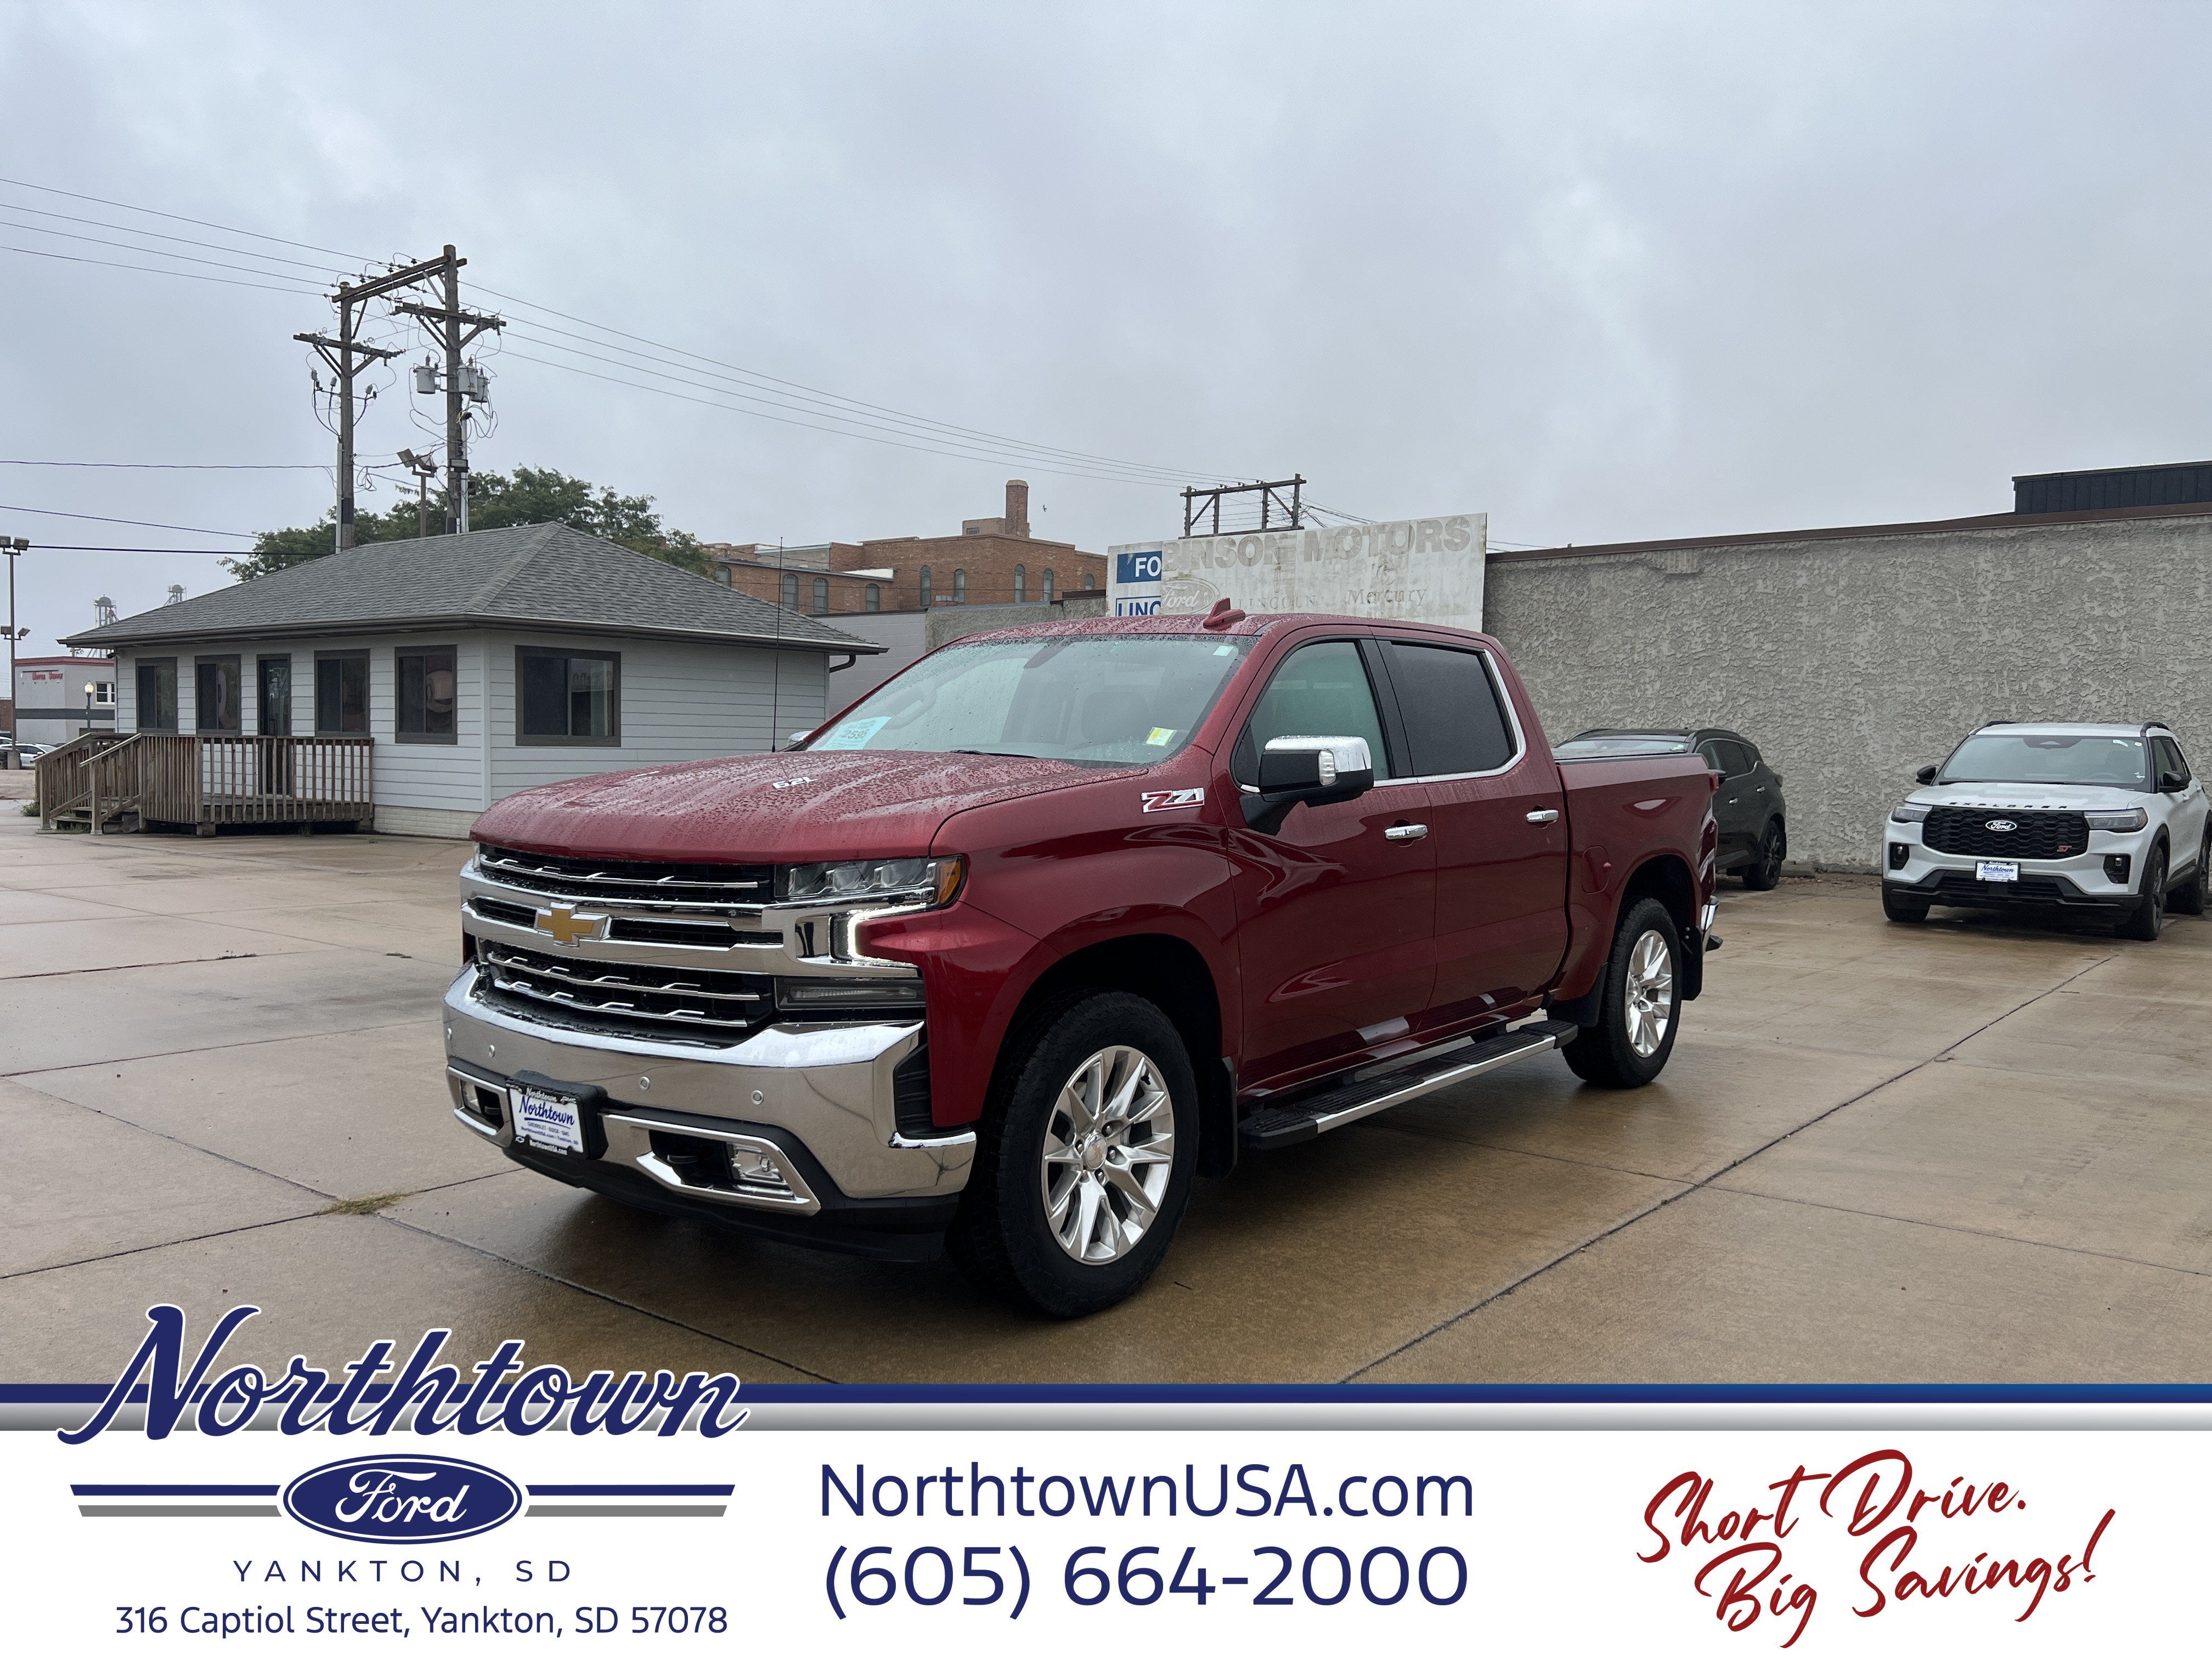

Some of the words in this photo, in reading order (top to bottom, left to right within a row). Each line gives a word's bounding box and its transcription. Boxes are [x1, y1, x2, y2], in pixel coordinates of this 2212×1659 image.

[1304, 516, 1470, 562] MOTORS
[1238, 595, 1317, 610] LINCOLN
[1345, 589, 1427, 606] Mercury
[519, 1096, 575, 1125] Northtown
